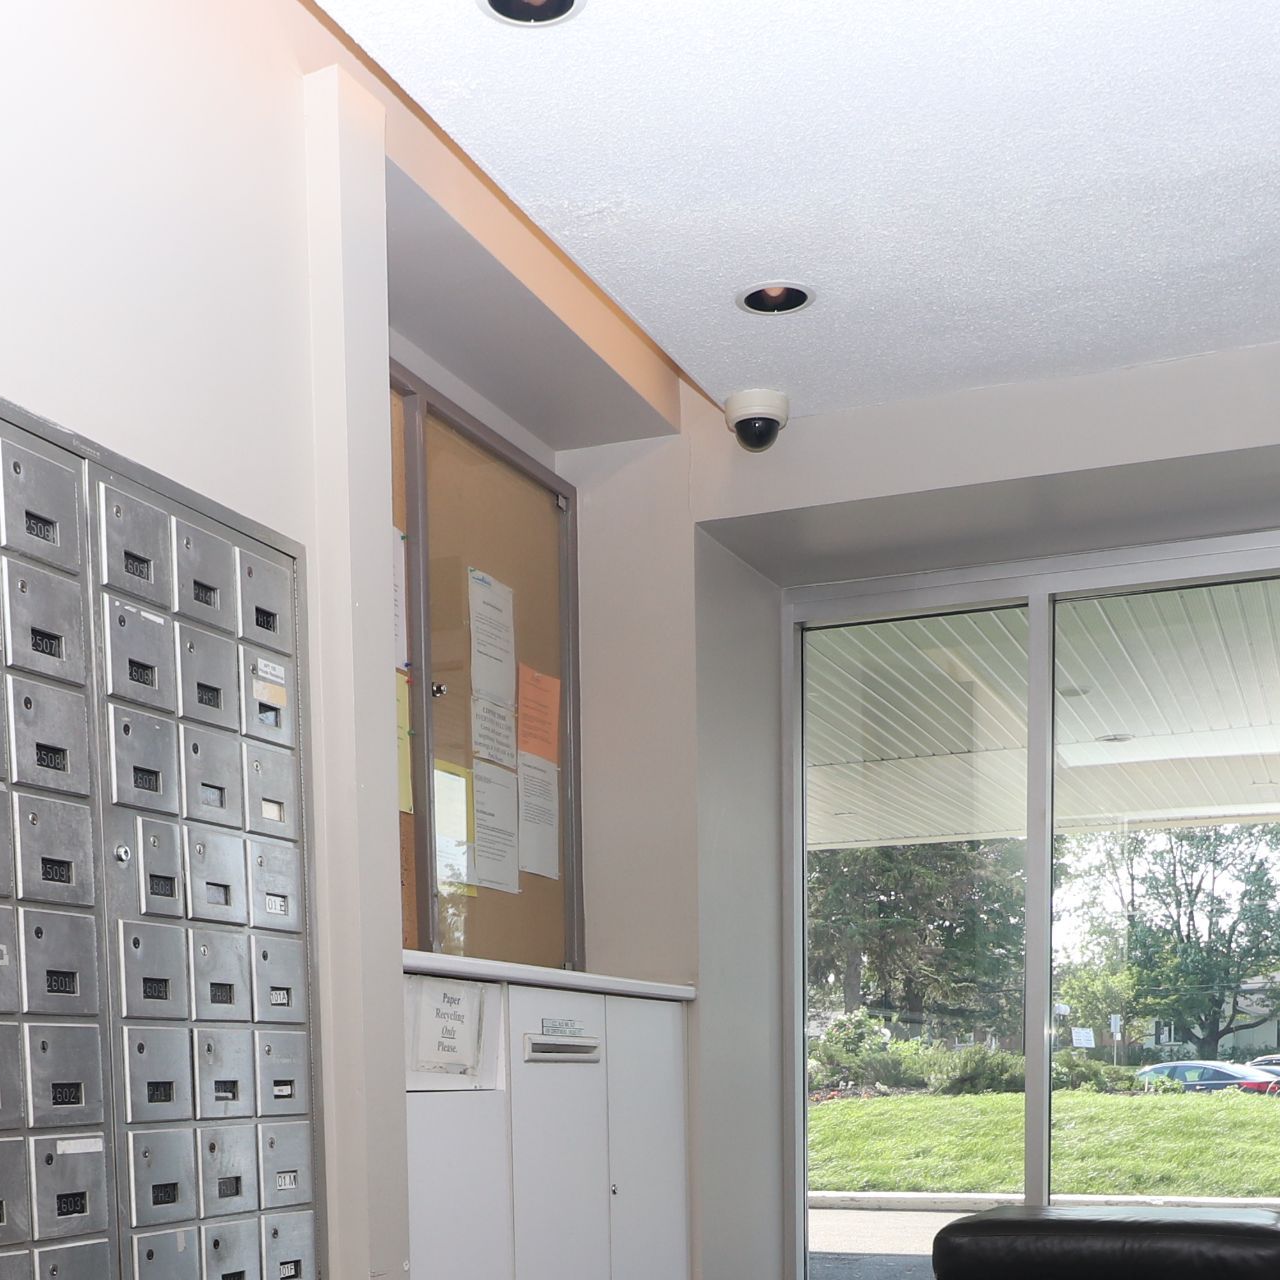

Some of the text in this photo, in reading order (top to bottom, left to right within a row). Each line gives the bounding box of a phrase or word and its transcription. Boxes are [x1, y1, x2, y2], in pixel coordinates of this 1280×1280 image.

[31, 637, 56, 656] 2507
[36, 751, 60, 769] 2508
[41, 864, 66, 881] 2509
[46, 975, 69, 991] 2601
[442, 992, 461, 1006] Paper
[435, 1008, 465, 1024] Recycling
[441, 1026, 456, 1038] Only
